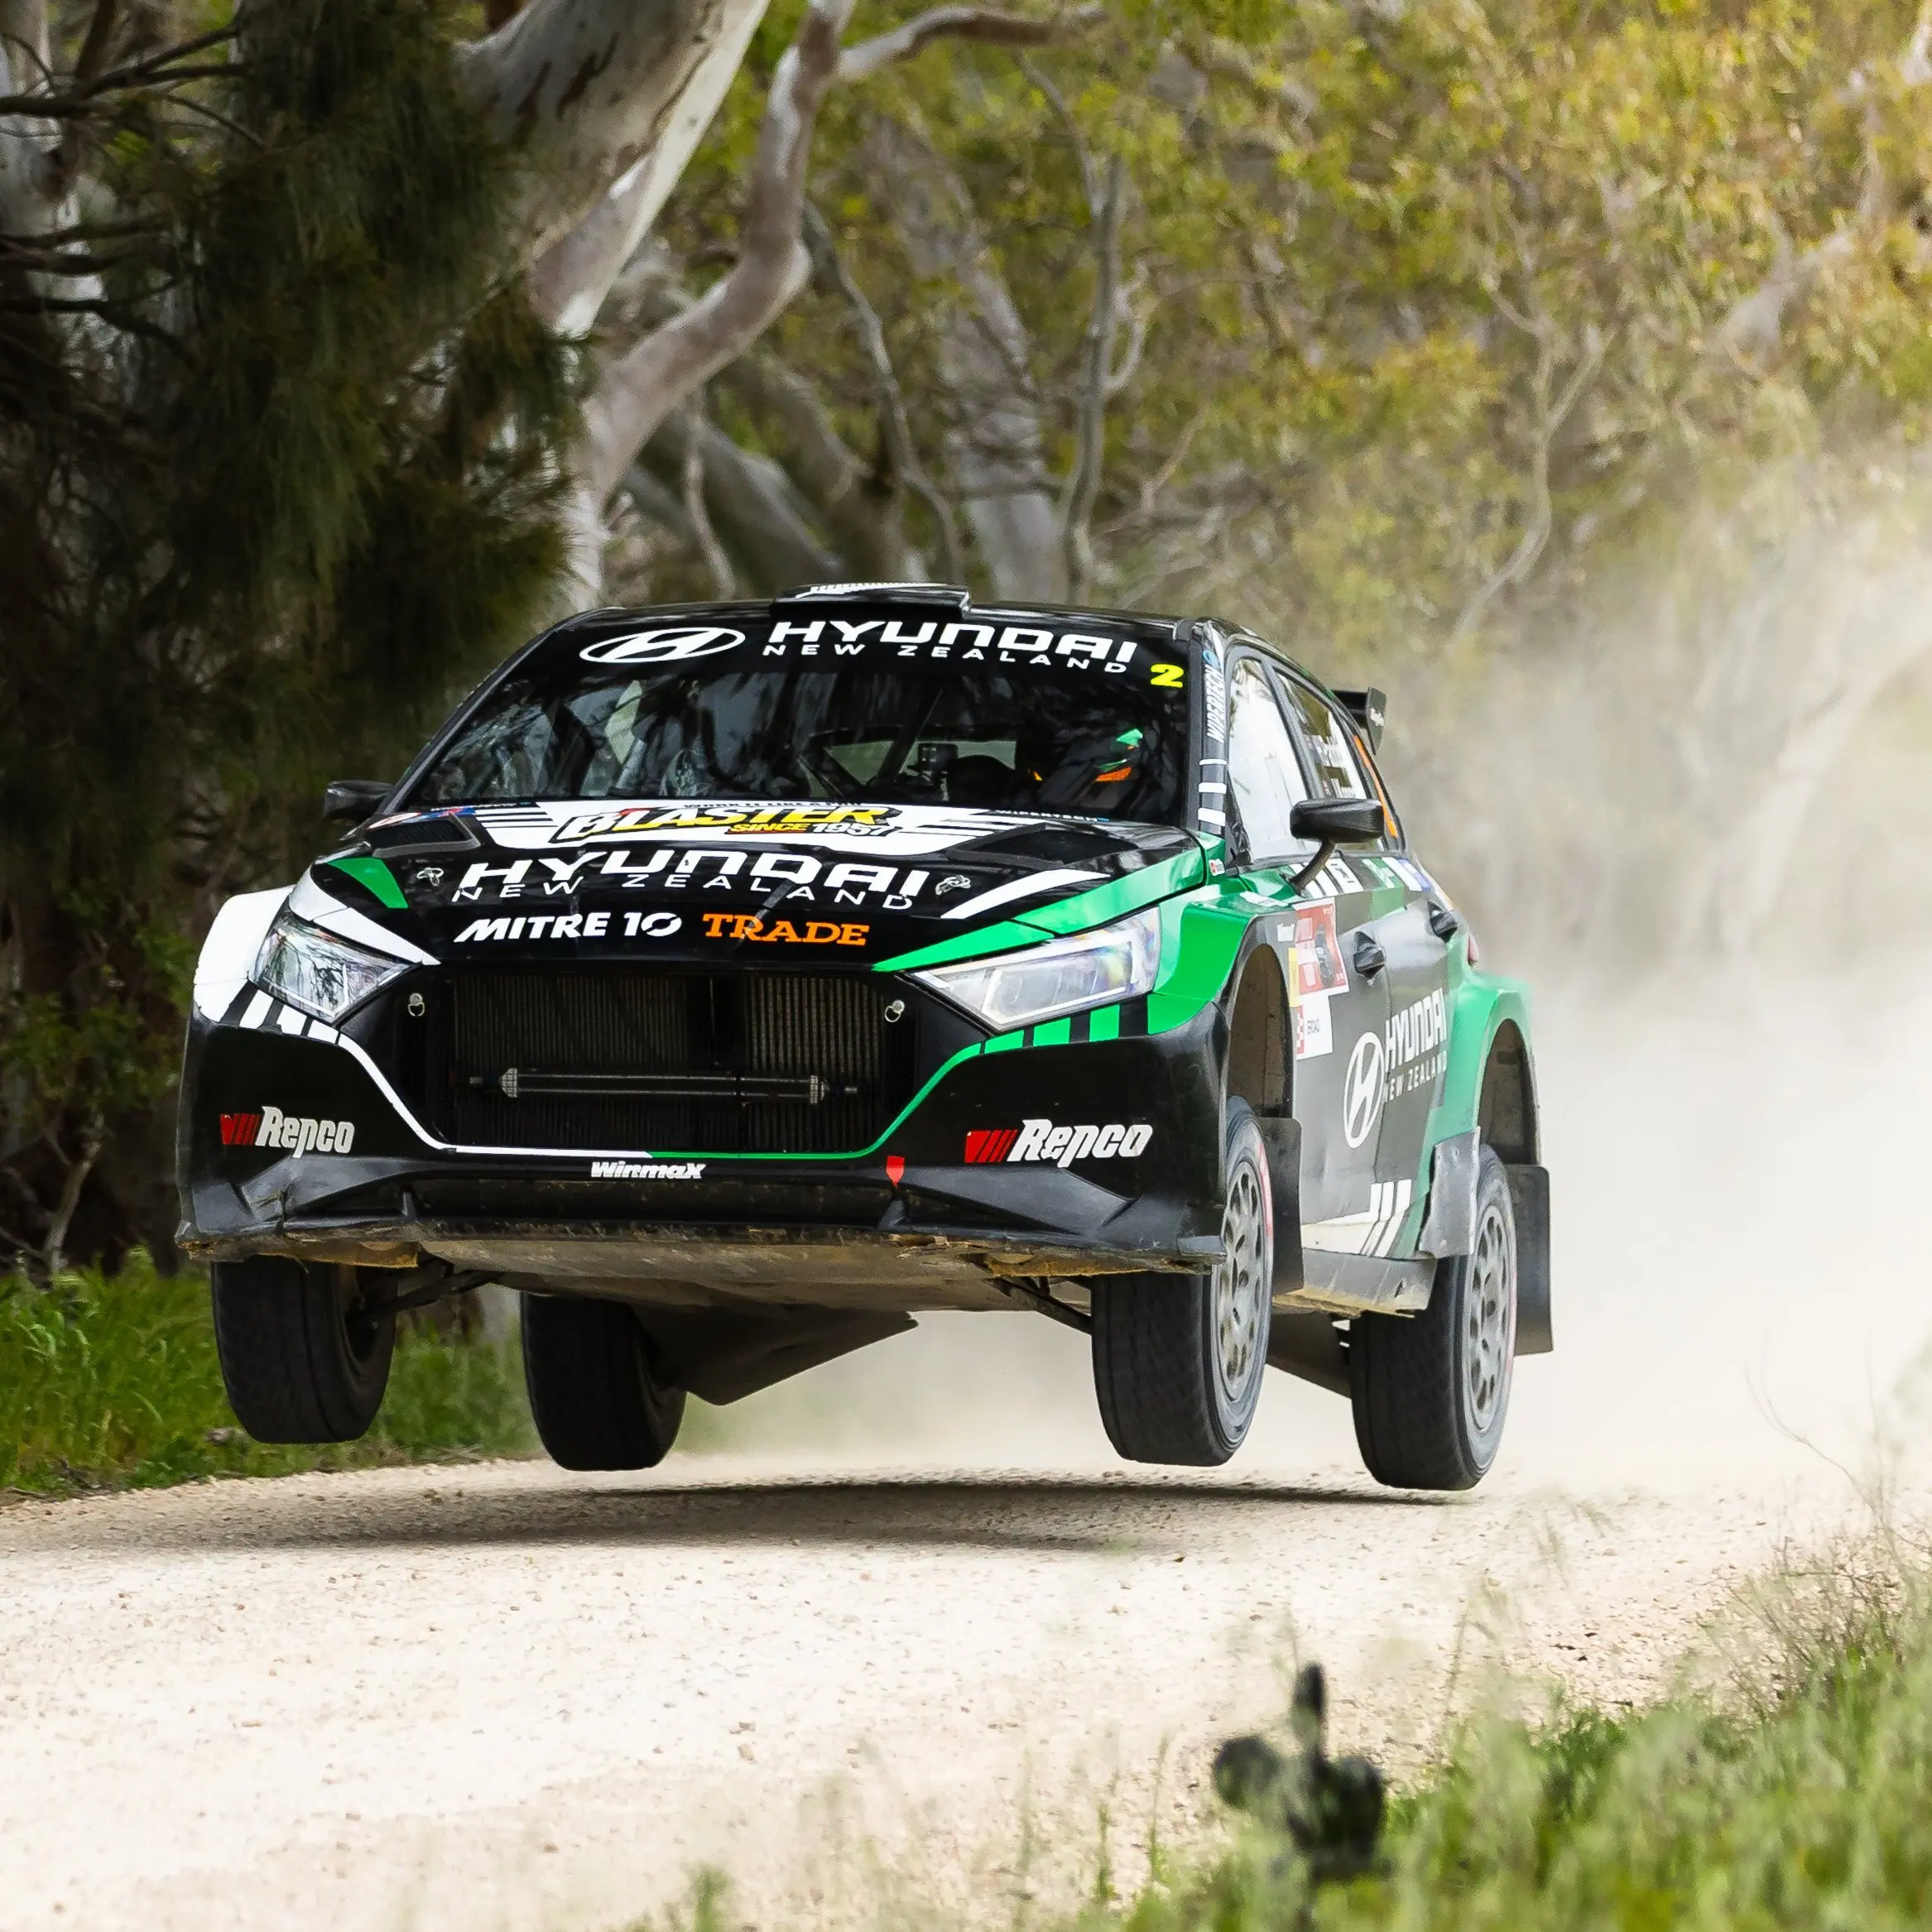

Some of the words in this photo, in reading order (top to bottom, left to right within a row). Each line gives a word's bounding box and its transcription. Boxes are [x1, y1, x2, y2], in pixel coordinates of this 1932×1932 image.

[762, 644, 865, 656] NEW
[898, 645, 1127, 674] ZEALAND
[769, 620, 1137, 663] HYUNDAI
[1150, 664, 1184, 689] 2
[1204, 664, 1225, 743] WIPERTECH
[550, 806, 901, 843] BLASTER
[729, 823, 811, 833] SINCE
[811, 823, 897, 836] 1957
[451, 877, 583, 902] NEW
[622, 874, 912, 910] ZEALAND
[461, 850, 930, 897] HYUNDAI
[454, 912, 612, 943] MITRE
[623, 911, 682, 937] 10
[702, 913, 870, 946] TRADE
[1385, 988, 1447, 1073] HYUNDAI
[1383, 1074, 1404, 1103] NEW
[1407, 1050, 1448, 1091] ZEALAND
[255, 1106, 355, 1157] Repco
[1007, 1118, 1153, 1168] Repco
